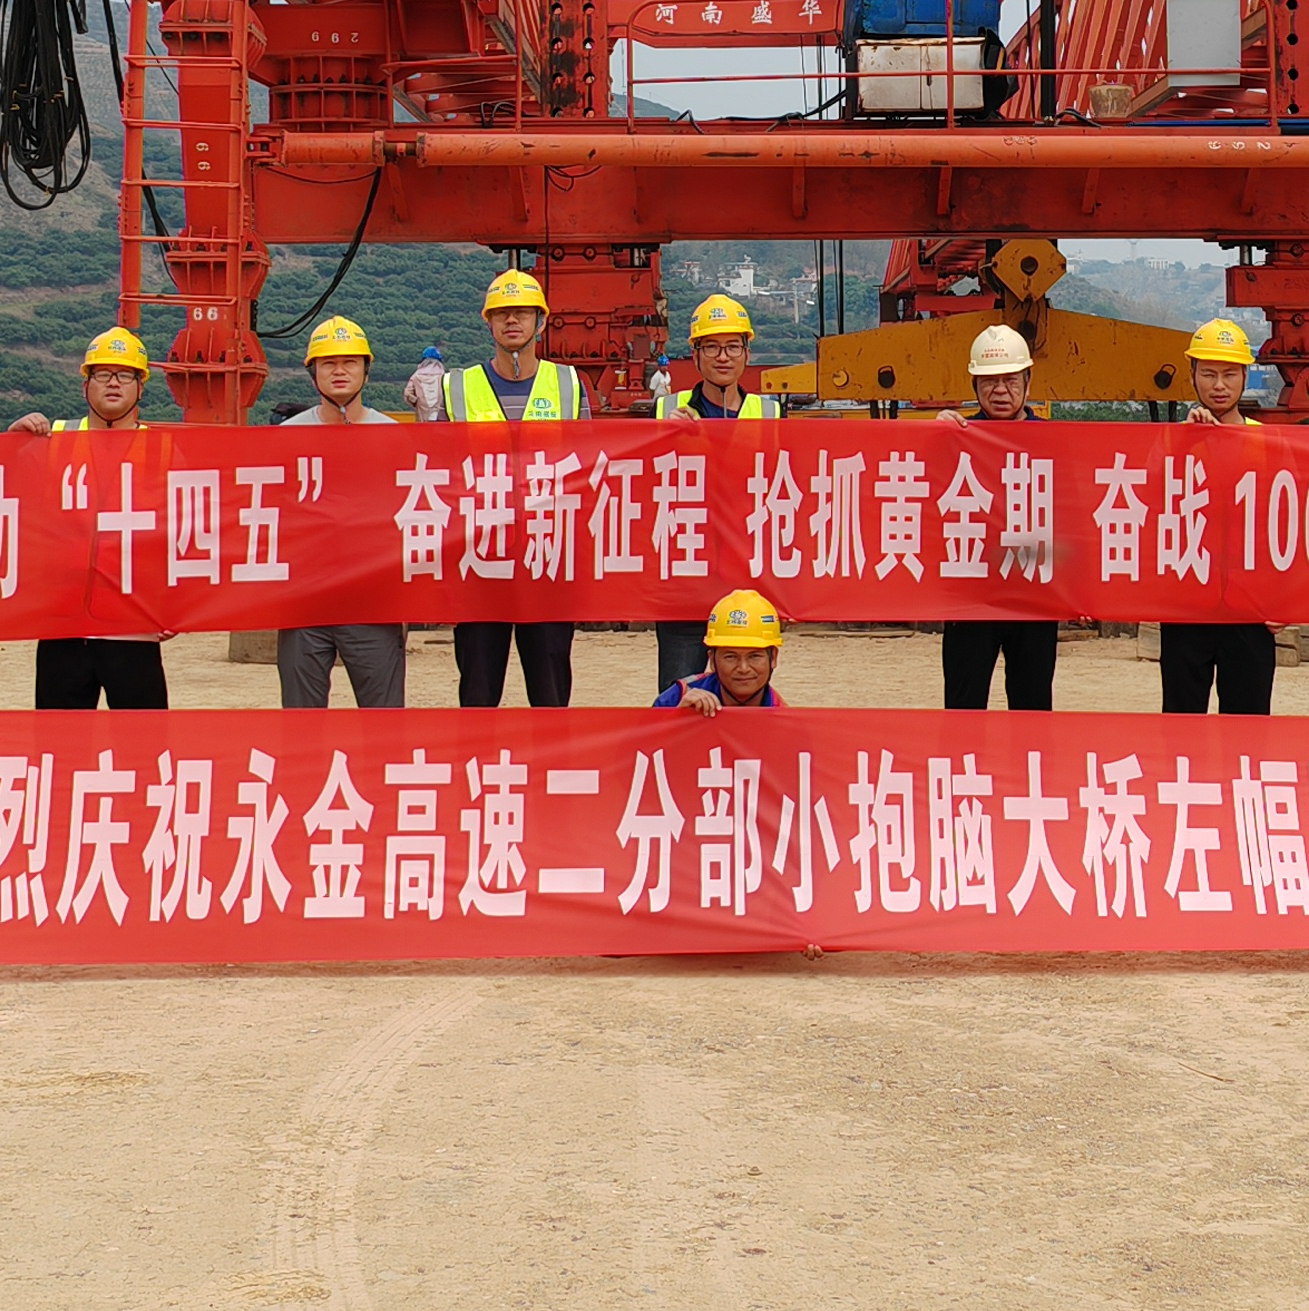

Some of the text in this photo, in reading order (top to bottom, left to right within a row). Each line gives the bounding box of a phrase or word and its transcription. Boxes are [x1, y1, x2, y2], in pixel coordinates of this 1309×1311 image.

[394, 451, 708, 582] 奋进新征程
[747, 450, 1054, 584] 抢抓黄金期
